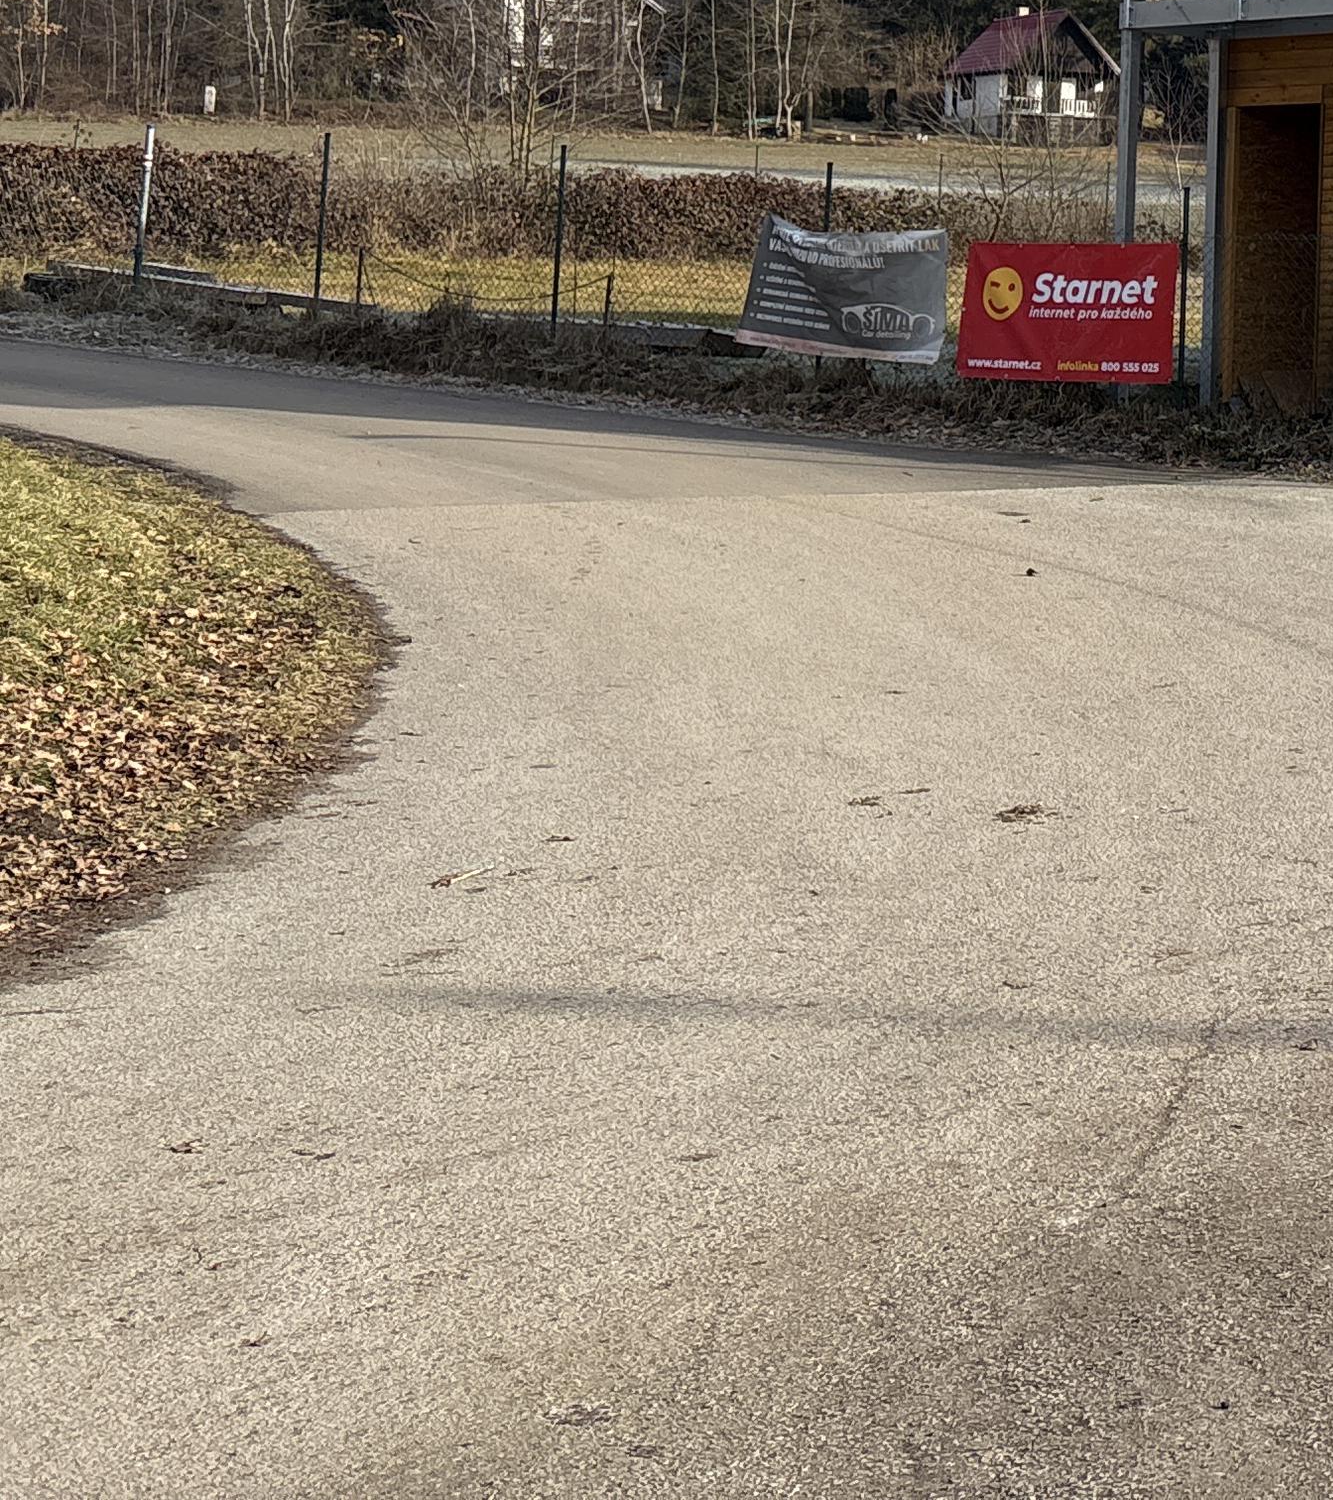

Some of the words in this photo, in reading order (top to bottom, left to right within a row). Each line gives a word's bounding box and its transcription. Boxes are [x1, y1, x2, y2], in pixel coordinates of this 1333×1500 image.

[1032, 272, 1159, 305] Starnet
[1029, 305, 1075, 319] internet
[1077, 308, 1098, 321] pro
[1100, 306, 1152, 320] každého
[861, 329, 874, 338] Car
[875, 328, 912, 340] detailing
[967, 357, 1042, 371] www.starnet.cz
[1057, 360, 1099, 372] infolinka
[1101, 361, 1120, 372] 800
[1122, 362, 1140, 373] 555
[1141, 362, 1160, 373] 025
